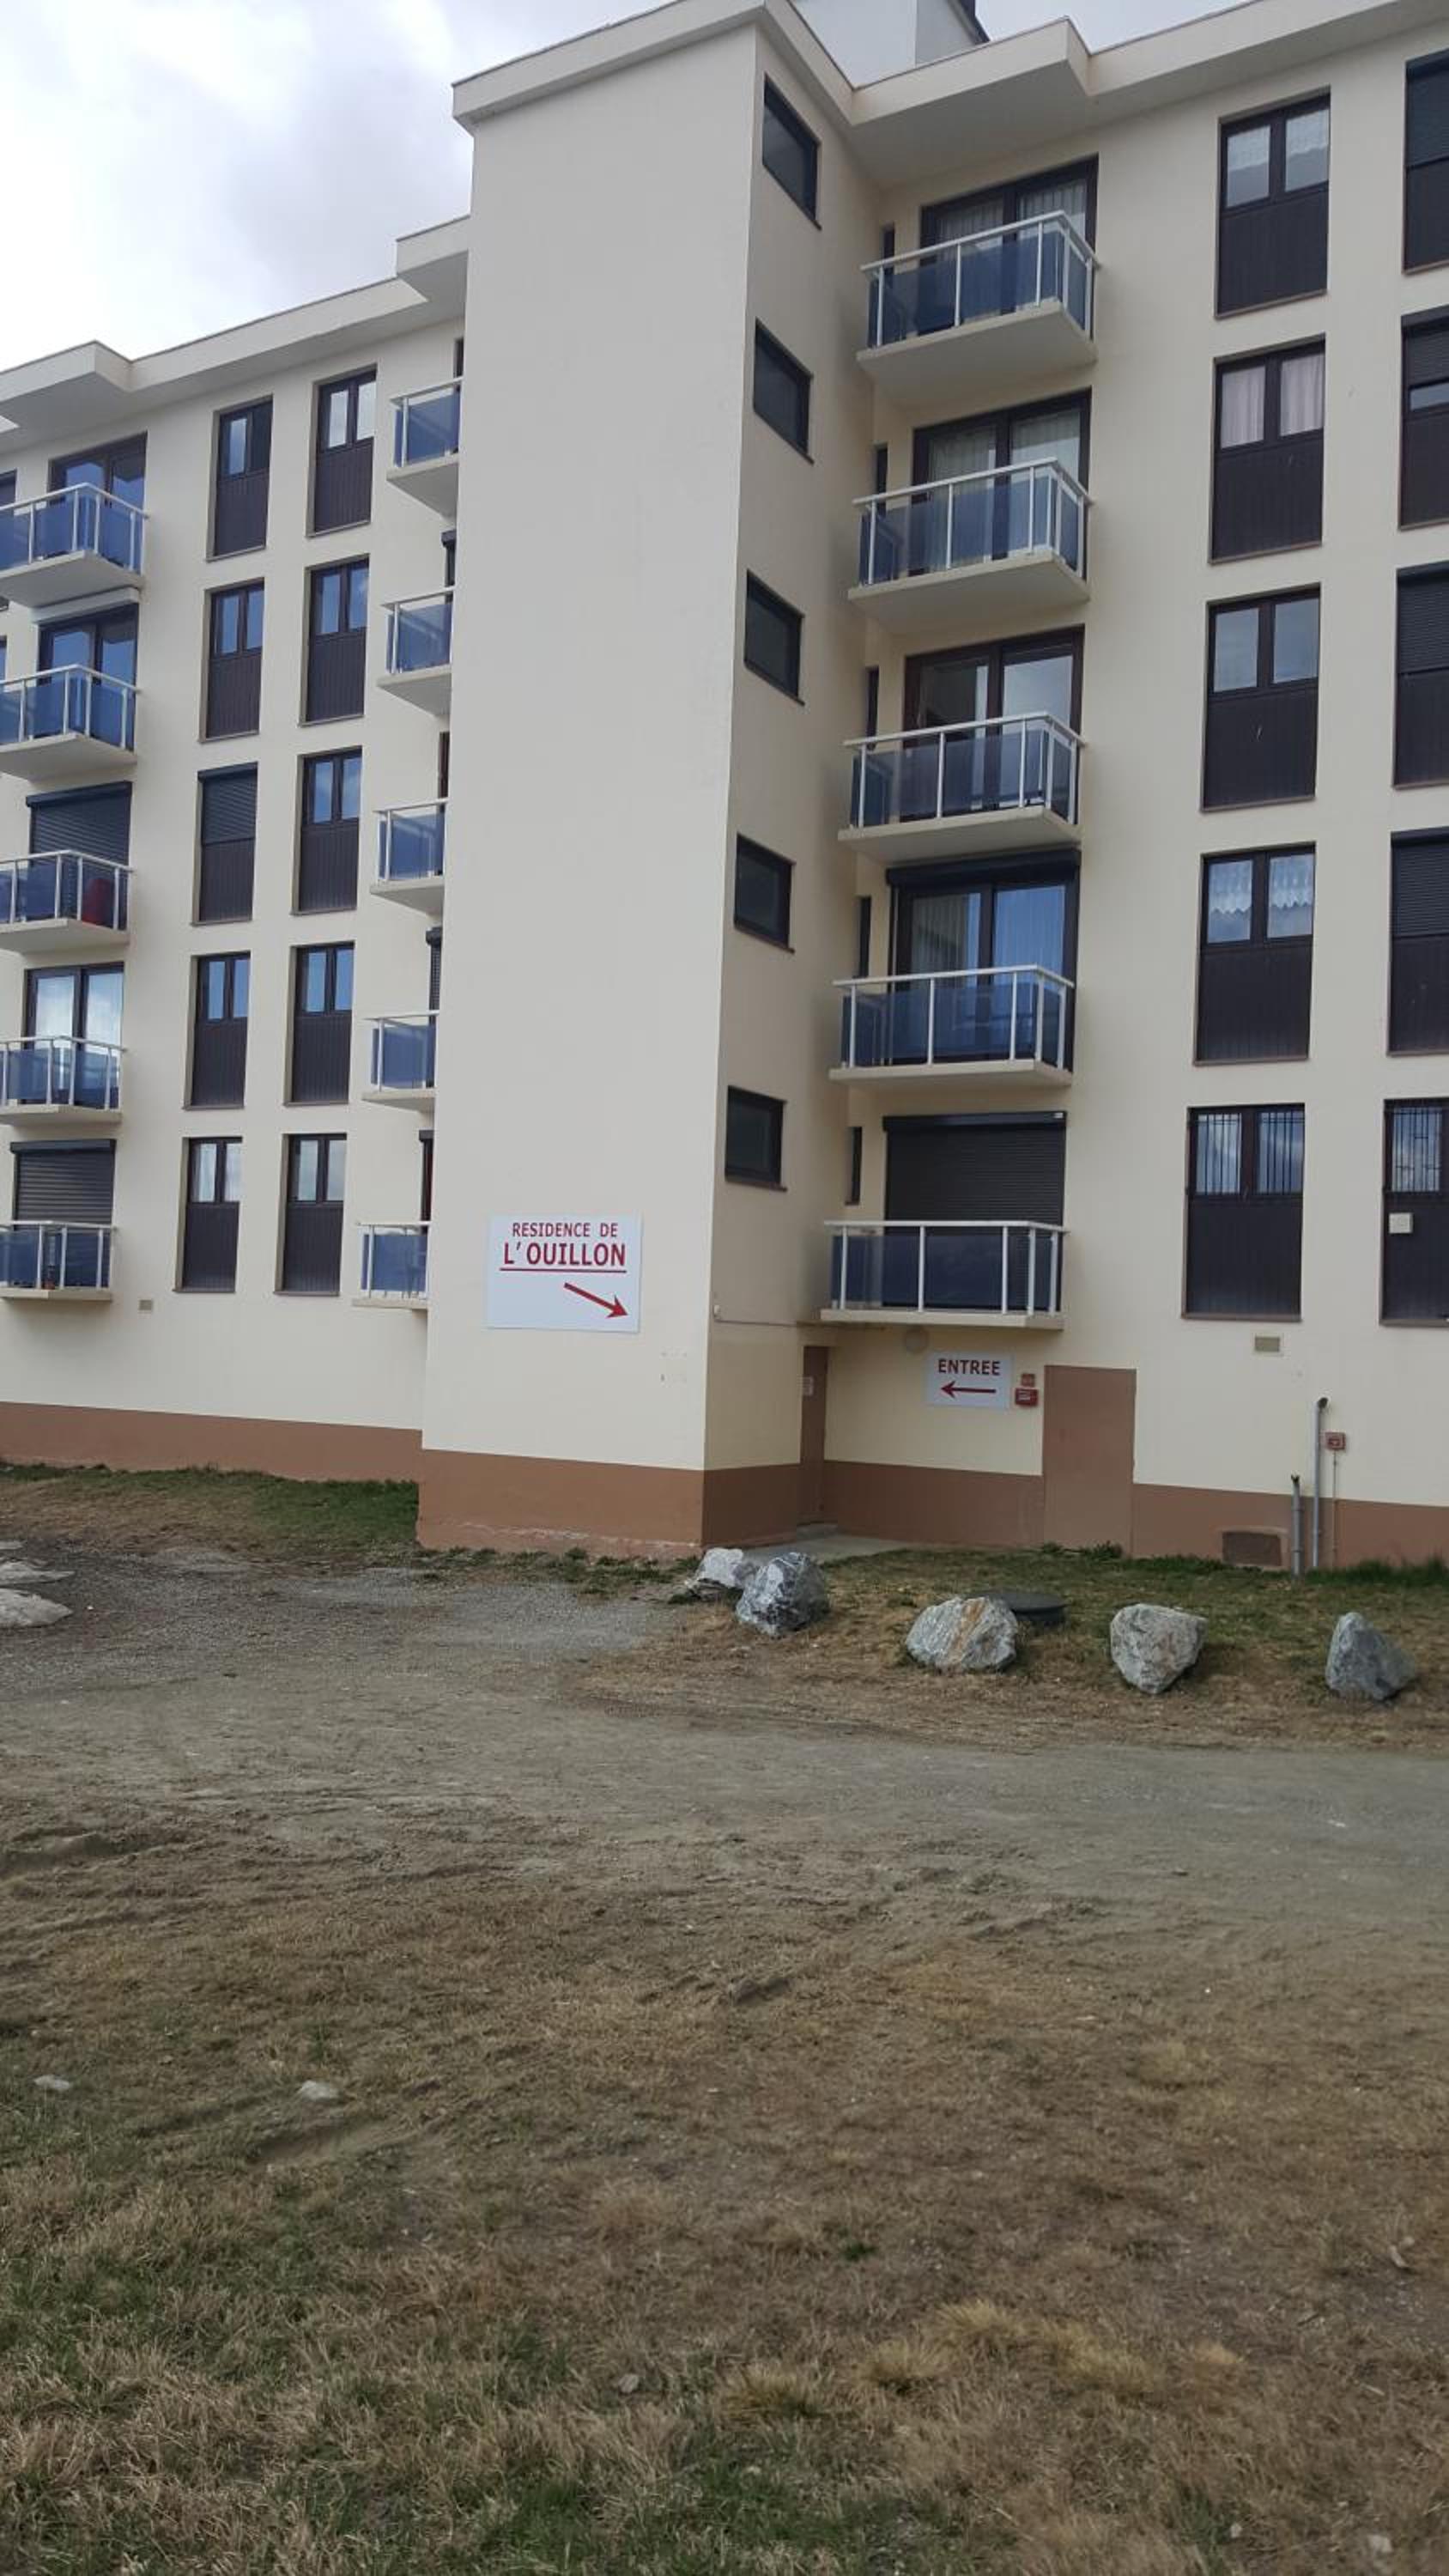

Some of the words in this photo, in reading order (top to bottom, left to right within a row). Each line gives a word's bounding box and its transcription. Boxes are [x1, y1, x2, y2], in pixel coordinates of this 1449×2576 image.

[512, 1222, 591, 1237] RESIDENCE
[599, 1222, 618, 1237] DE
[504, 1242, 626, 1267] L'OUILLON
[937, 1358, 1001, 1376] ENTREE
